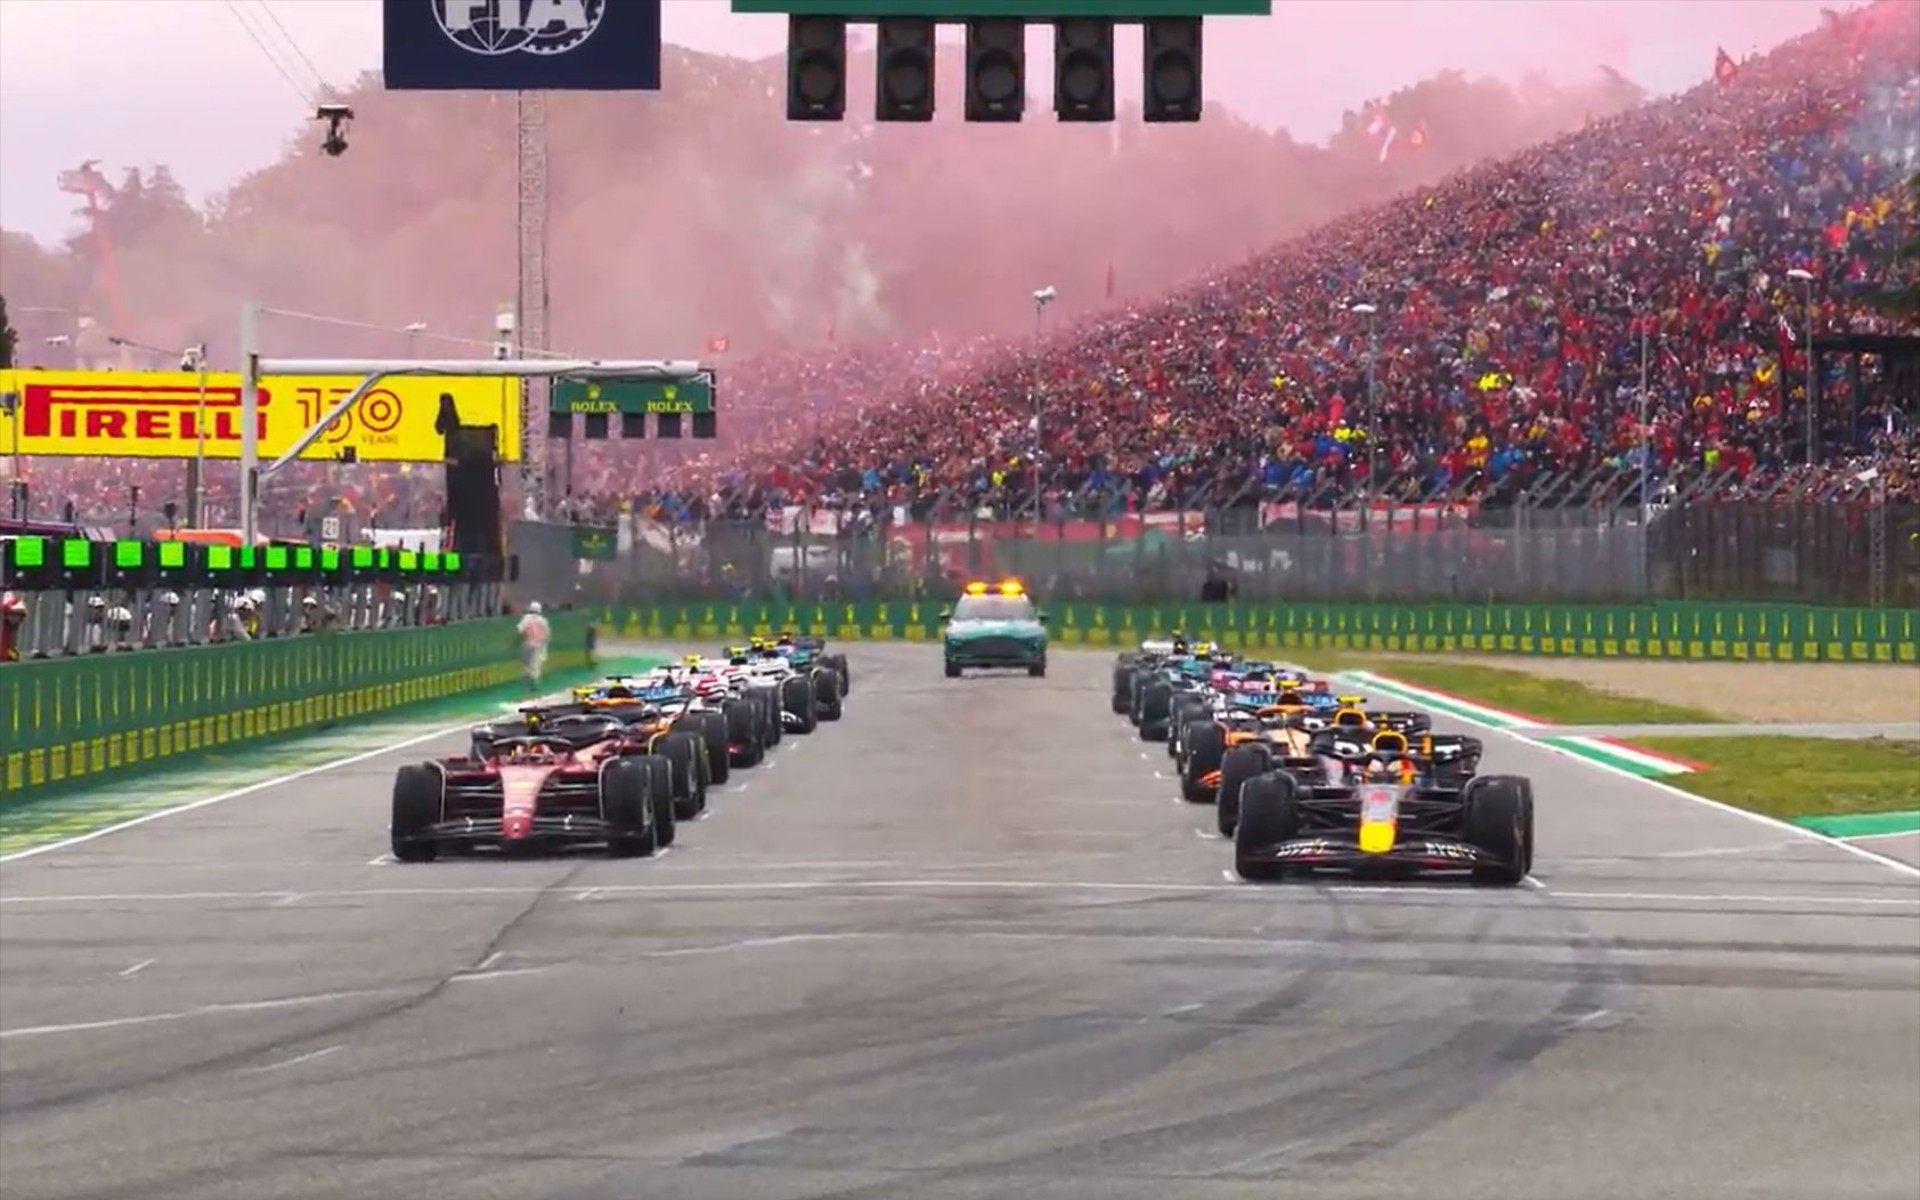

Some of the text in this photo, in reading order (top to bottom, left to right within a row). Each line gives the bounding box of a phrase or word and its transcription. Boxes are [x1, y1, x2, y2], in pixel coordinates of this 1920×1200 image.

[445, 0, 588, 29] FIA
[23, 384, 270, 440] PIRELLI
[296, 388, 402, 442] 150
[570, 402, 693, 412] ROLEX ROLEX
